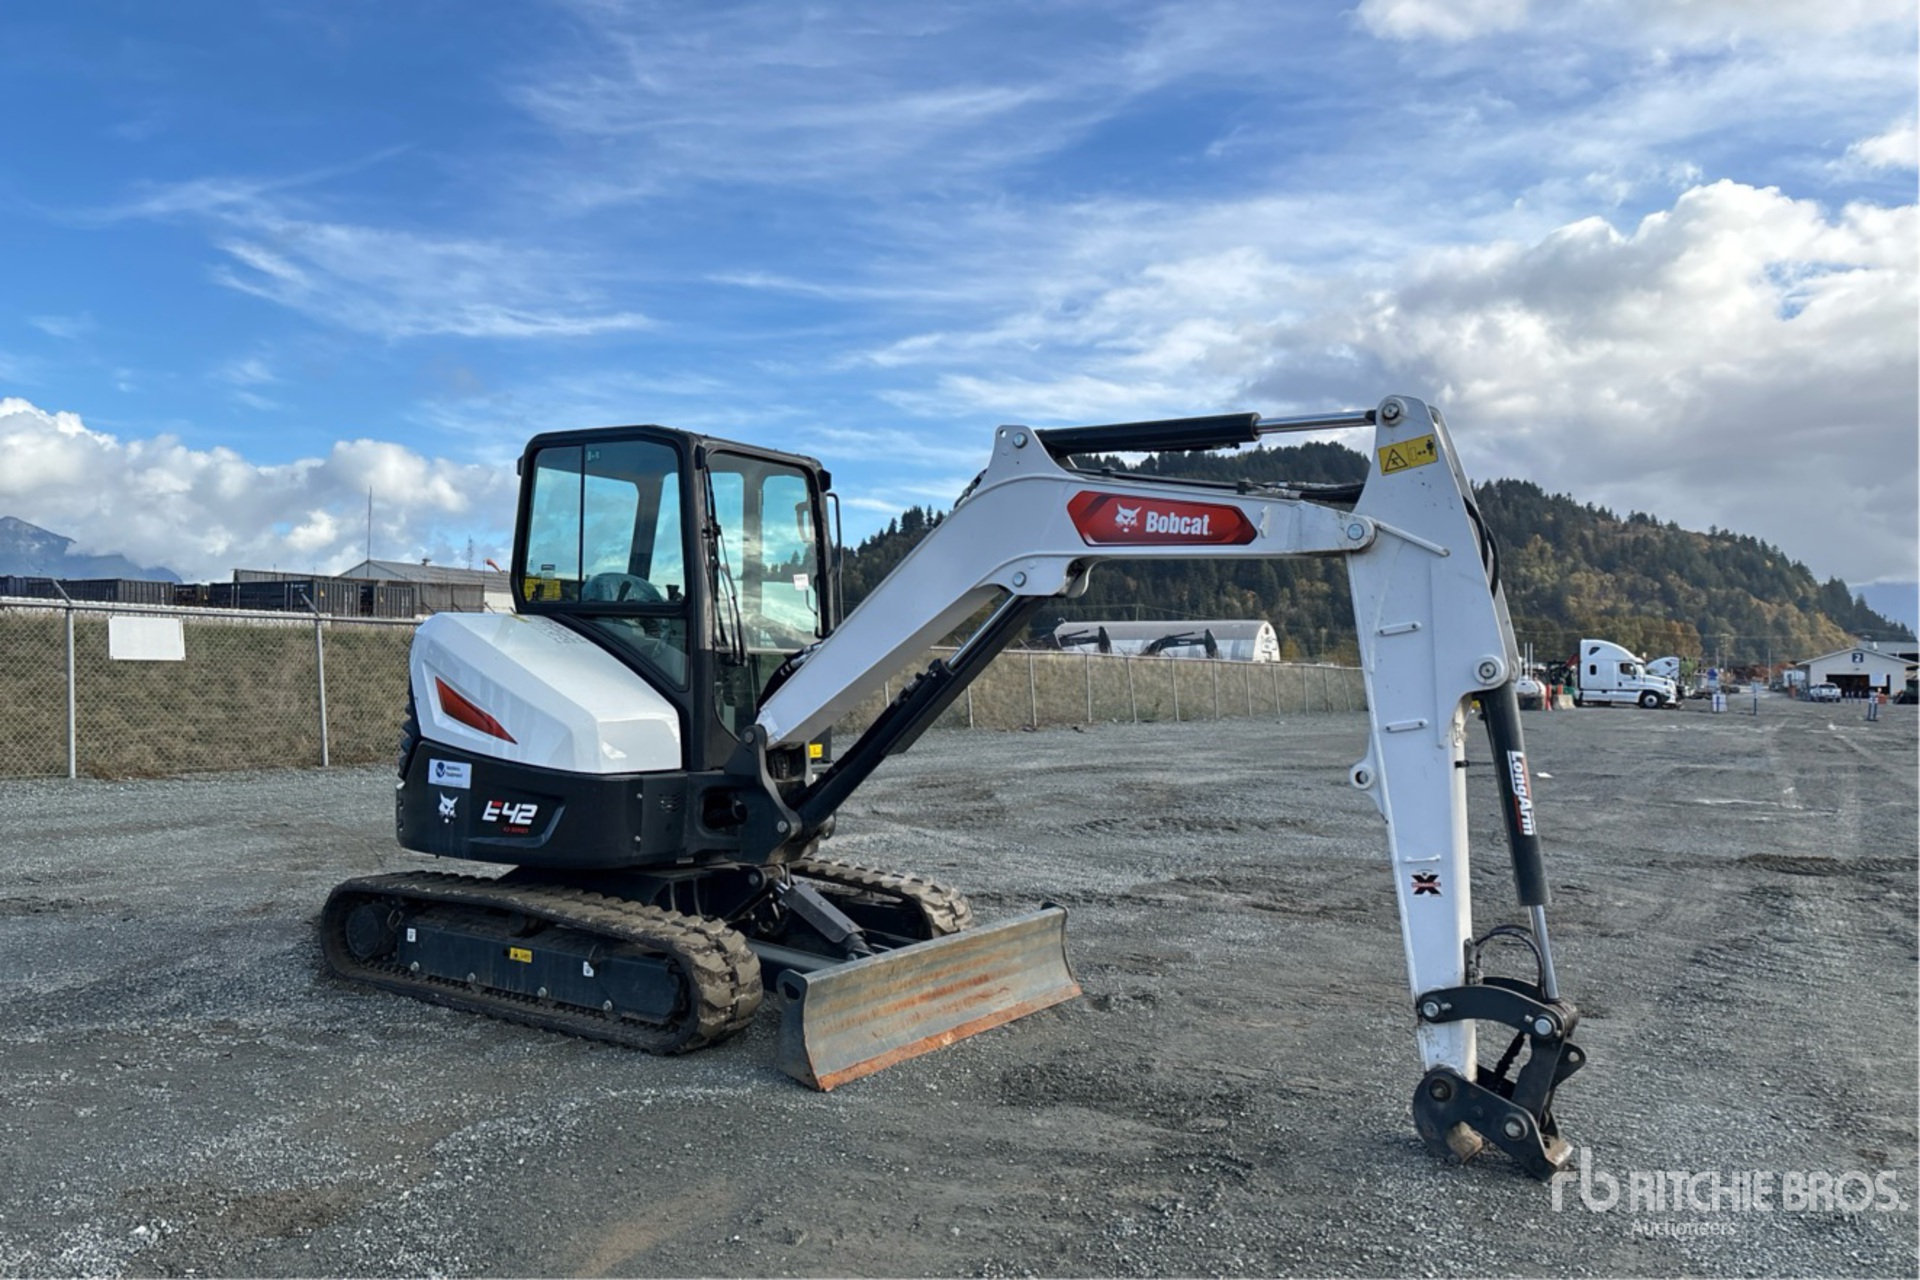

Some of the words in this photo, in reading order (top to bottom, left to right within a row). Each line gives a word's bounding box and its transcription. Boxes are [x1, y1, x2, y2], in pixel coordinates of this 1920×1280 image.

[1146, 511, 1210, 536] Bobcat
[1511, 751, 1534, 835] LongArm
[482, 800, 538, 825] E42
